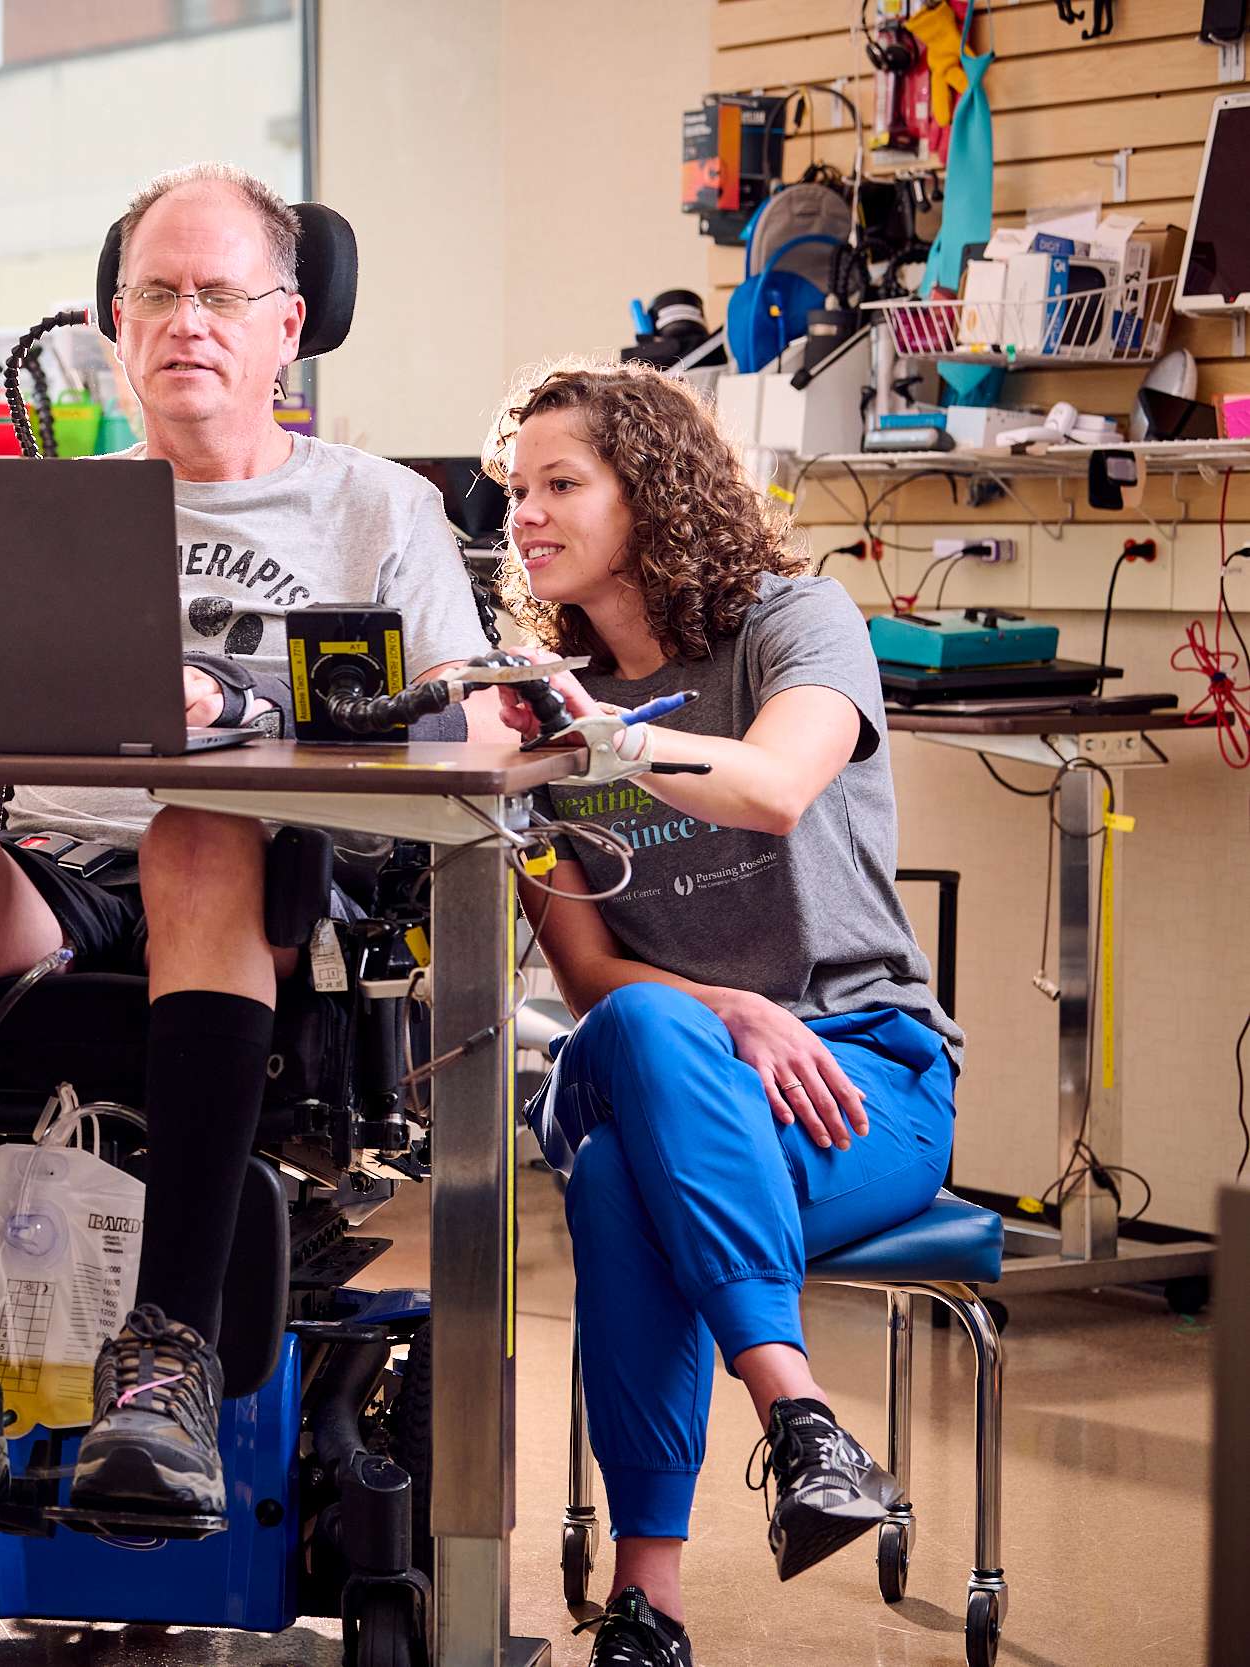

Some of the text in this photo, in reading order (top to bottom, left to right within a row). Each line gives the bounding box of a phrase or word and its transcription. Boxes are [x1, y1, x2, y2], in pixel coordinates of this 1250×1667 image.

[178, 543, 310, 606] ERAPIS
[610, 816, 696, 849] Since
[695, 851, 777, 882] Pursuing Possible
[633, 888, 662, 899] Center
[88, 1213, 141, 1234] BARD
[99, 1318, 116, 1328] 1000
[0, 1343, 5, 1351] 5
